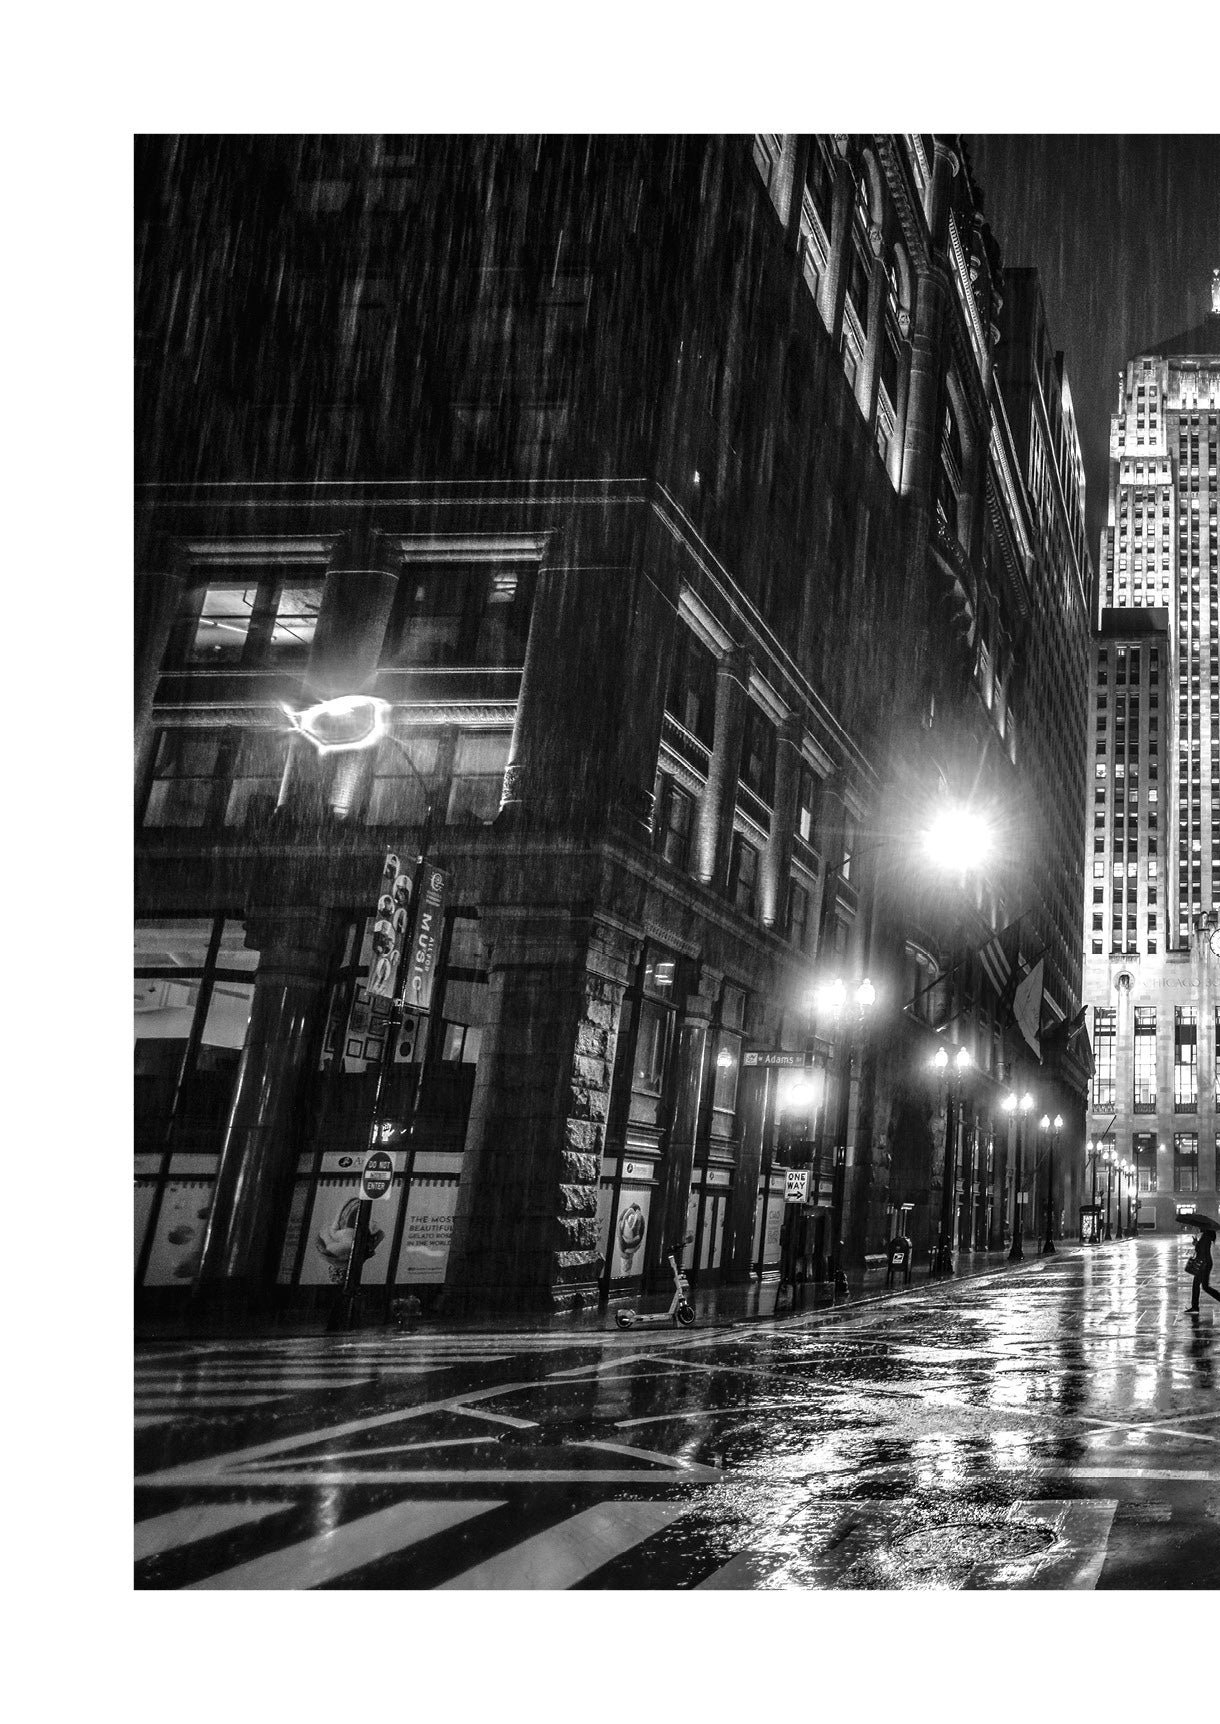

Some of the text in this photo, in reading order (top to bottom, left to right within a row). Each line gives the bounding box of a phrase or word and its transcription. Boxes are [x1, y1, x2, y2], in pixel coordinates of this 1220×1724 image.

[427, 936, 435, 951] ALL
[411, 912, 433, 992] MUSIC
[1142, 977, 1201, 987] CHICAGO
[764, 1054, 794, 1064] Adams
[368, 1160, 378, 1169] DO
[379, 1161, 391, 1169] NOT
[788, 1173, 806, 1181] ONE
[367, 1182, 386, 1190] ENTER
[787, 1182, 806, 1190] WAY
[411, 1215, 456, 1223] THE MOST
